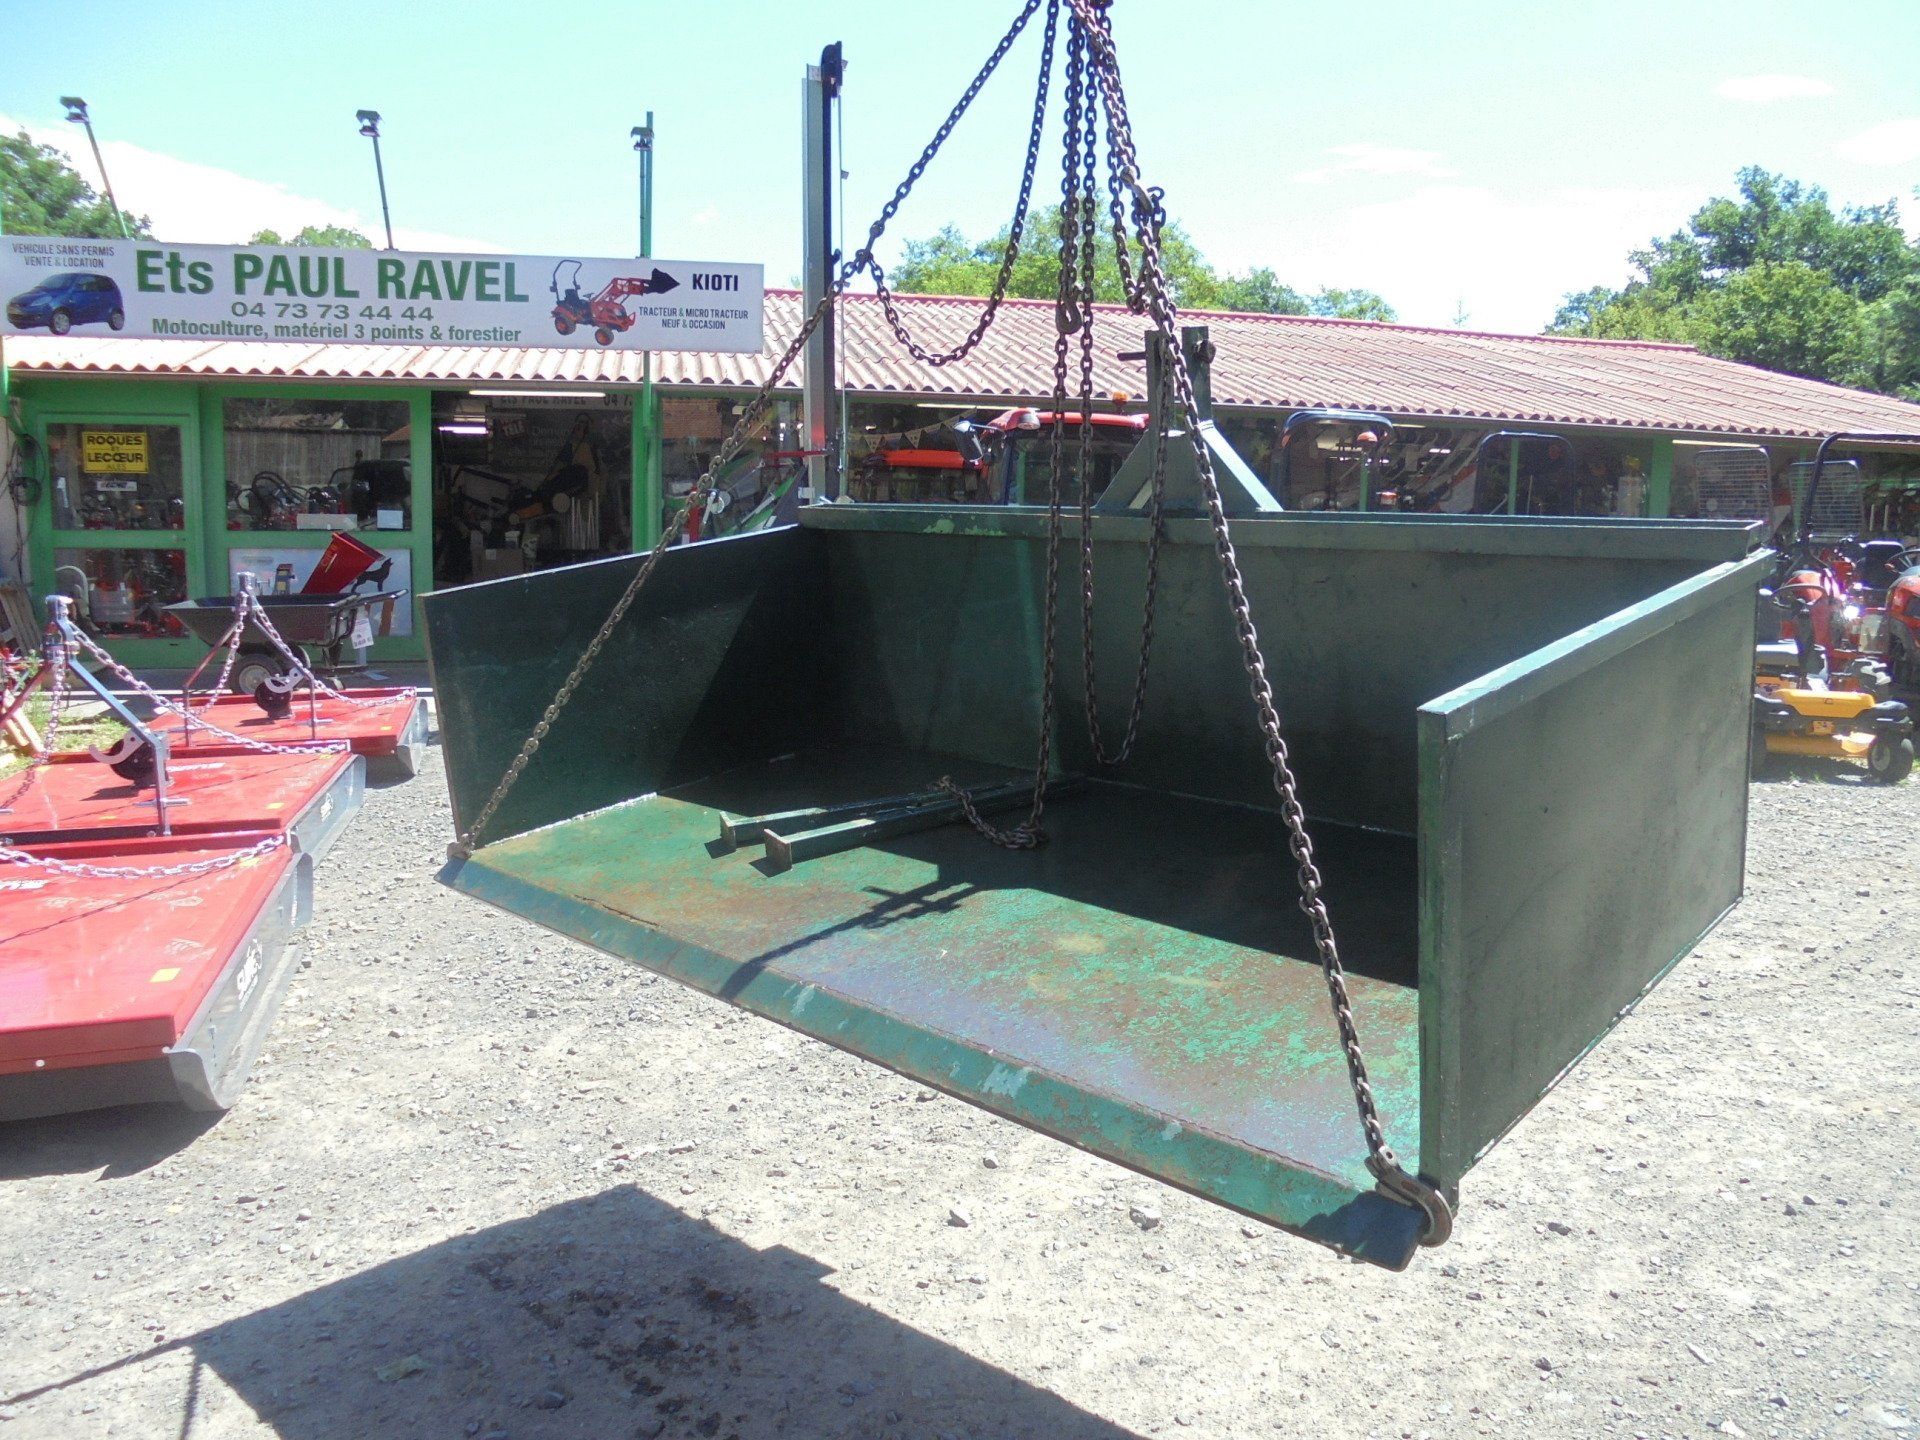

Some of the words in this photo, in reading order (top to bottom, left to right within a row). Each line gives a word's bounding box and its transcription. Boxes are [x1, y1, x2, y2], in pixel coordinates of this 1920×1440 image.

[12, 243, 54, 255] VEHICULE
[56, 245, 80, 255] SANS
[81, 246, 115, 256] PERMIS
[24, 256, 52, 266] VENTE
[54, 258, 61, 267] &
[63, 258, 104, 268] LOCATION
[136, 249, 214, 295] Ets
[233, 253, 360, 299] PAUL
[377, 258, 530, 303] RAVEL
[692, 273, 739, 292] KIOTI
[231, 301, 266, 318] 04
[274, 303, 308, 319] 73
[316, 304, 350, 320] 73
[359, 305, 392, 320] 44
[400, 306, 434, 321] 44
[639, 306, 678, 317] TRACTEUR
[679, 308, 685, 317] &
[686, 308, 709, 319] MICRO
[711, 309, 749, 320] TRACTEUR
[152, 318, 269, 340] Motoculture,
[274, 322, 348, 338] matériel
[354, 324, 365, 339] 3
[371, 324, 424, 342] points
[430, 325, 443, 340] &
[449, 326, 522, 342] forestier
[662, 319, 680, 329] NEUF
[682, 320, 688, 329] &
[689, 320, 726, 330] OCCASION
[86, 435, 143, 446] ROQUES
[88, 452, 144, 463] LECŒUR
